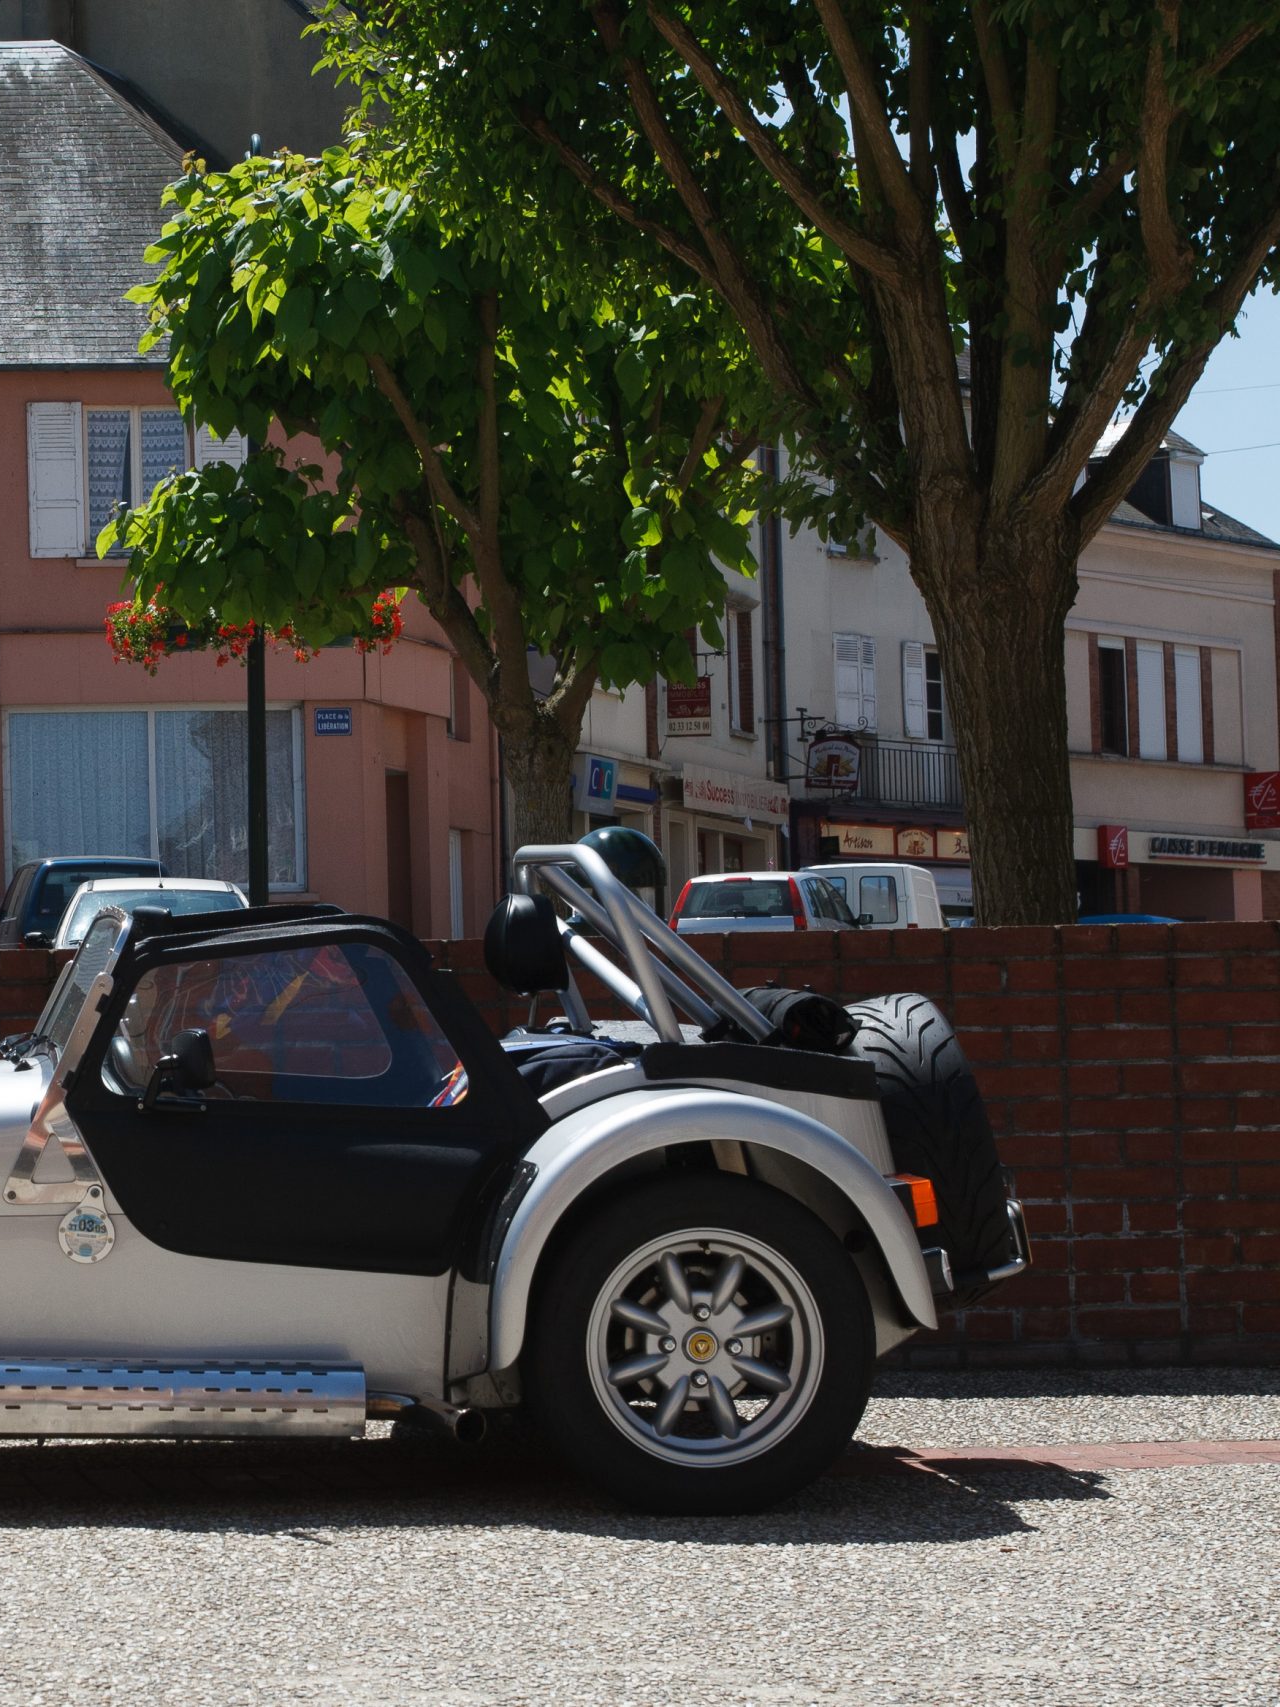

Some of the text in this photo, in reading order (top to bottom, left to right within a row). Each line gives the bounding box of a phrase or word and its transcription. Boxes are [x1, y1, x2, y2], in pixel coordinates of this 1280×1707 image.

[318, 721, 348, 730] LIBÉRATION
[591, 767, 612, 792] CIC
[843, 829, 873, 848] Artisan
[1150, 837, 1195, 855] CAISSE
[79, 1219, 94, 1232] 03
[95, 1224, 107, 1233] 09
